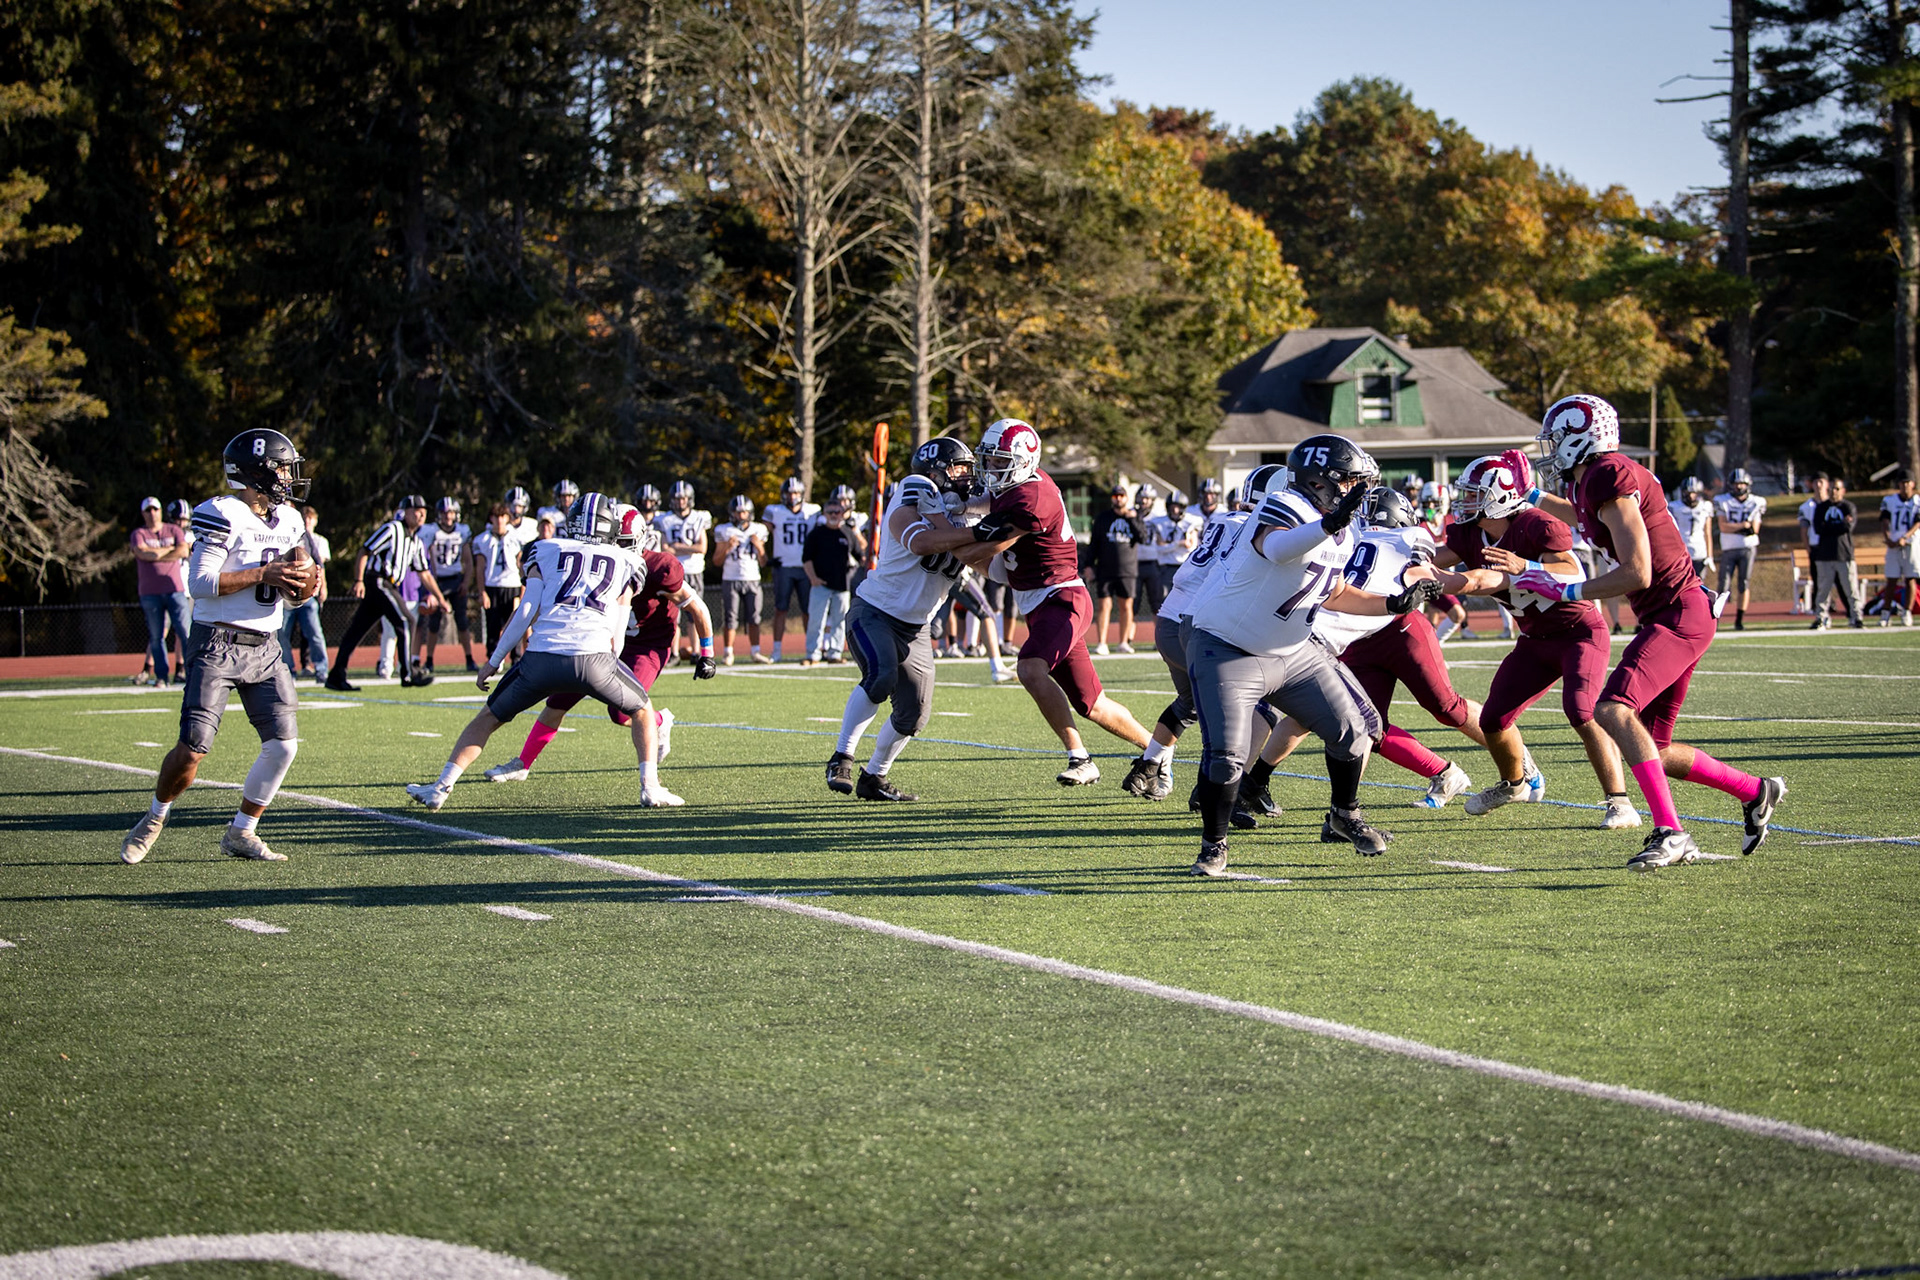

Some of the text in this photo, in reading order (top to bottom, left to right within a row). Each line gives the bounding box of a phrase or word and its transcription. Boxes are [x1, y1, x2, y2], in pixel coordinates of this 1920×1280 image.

[252, 438, 266, 456] 8
[919, 443, 940, 460] 50
[1303, 446, 1330, 467] 75
[574, 533, 602, 544] Riddell
[783, 522, 808, 546] 58
[553, 552, 616, 616] 22
[1274, 561, 1346, 627] 75
